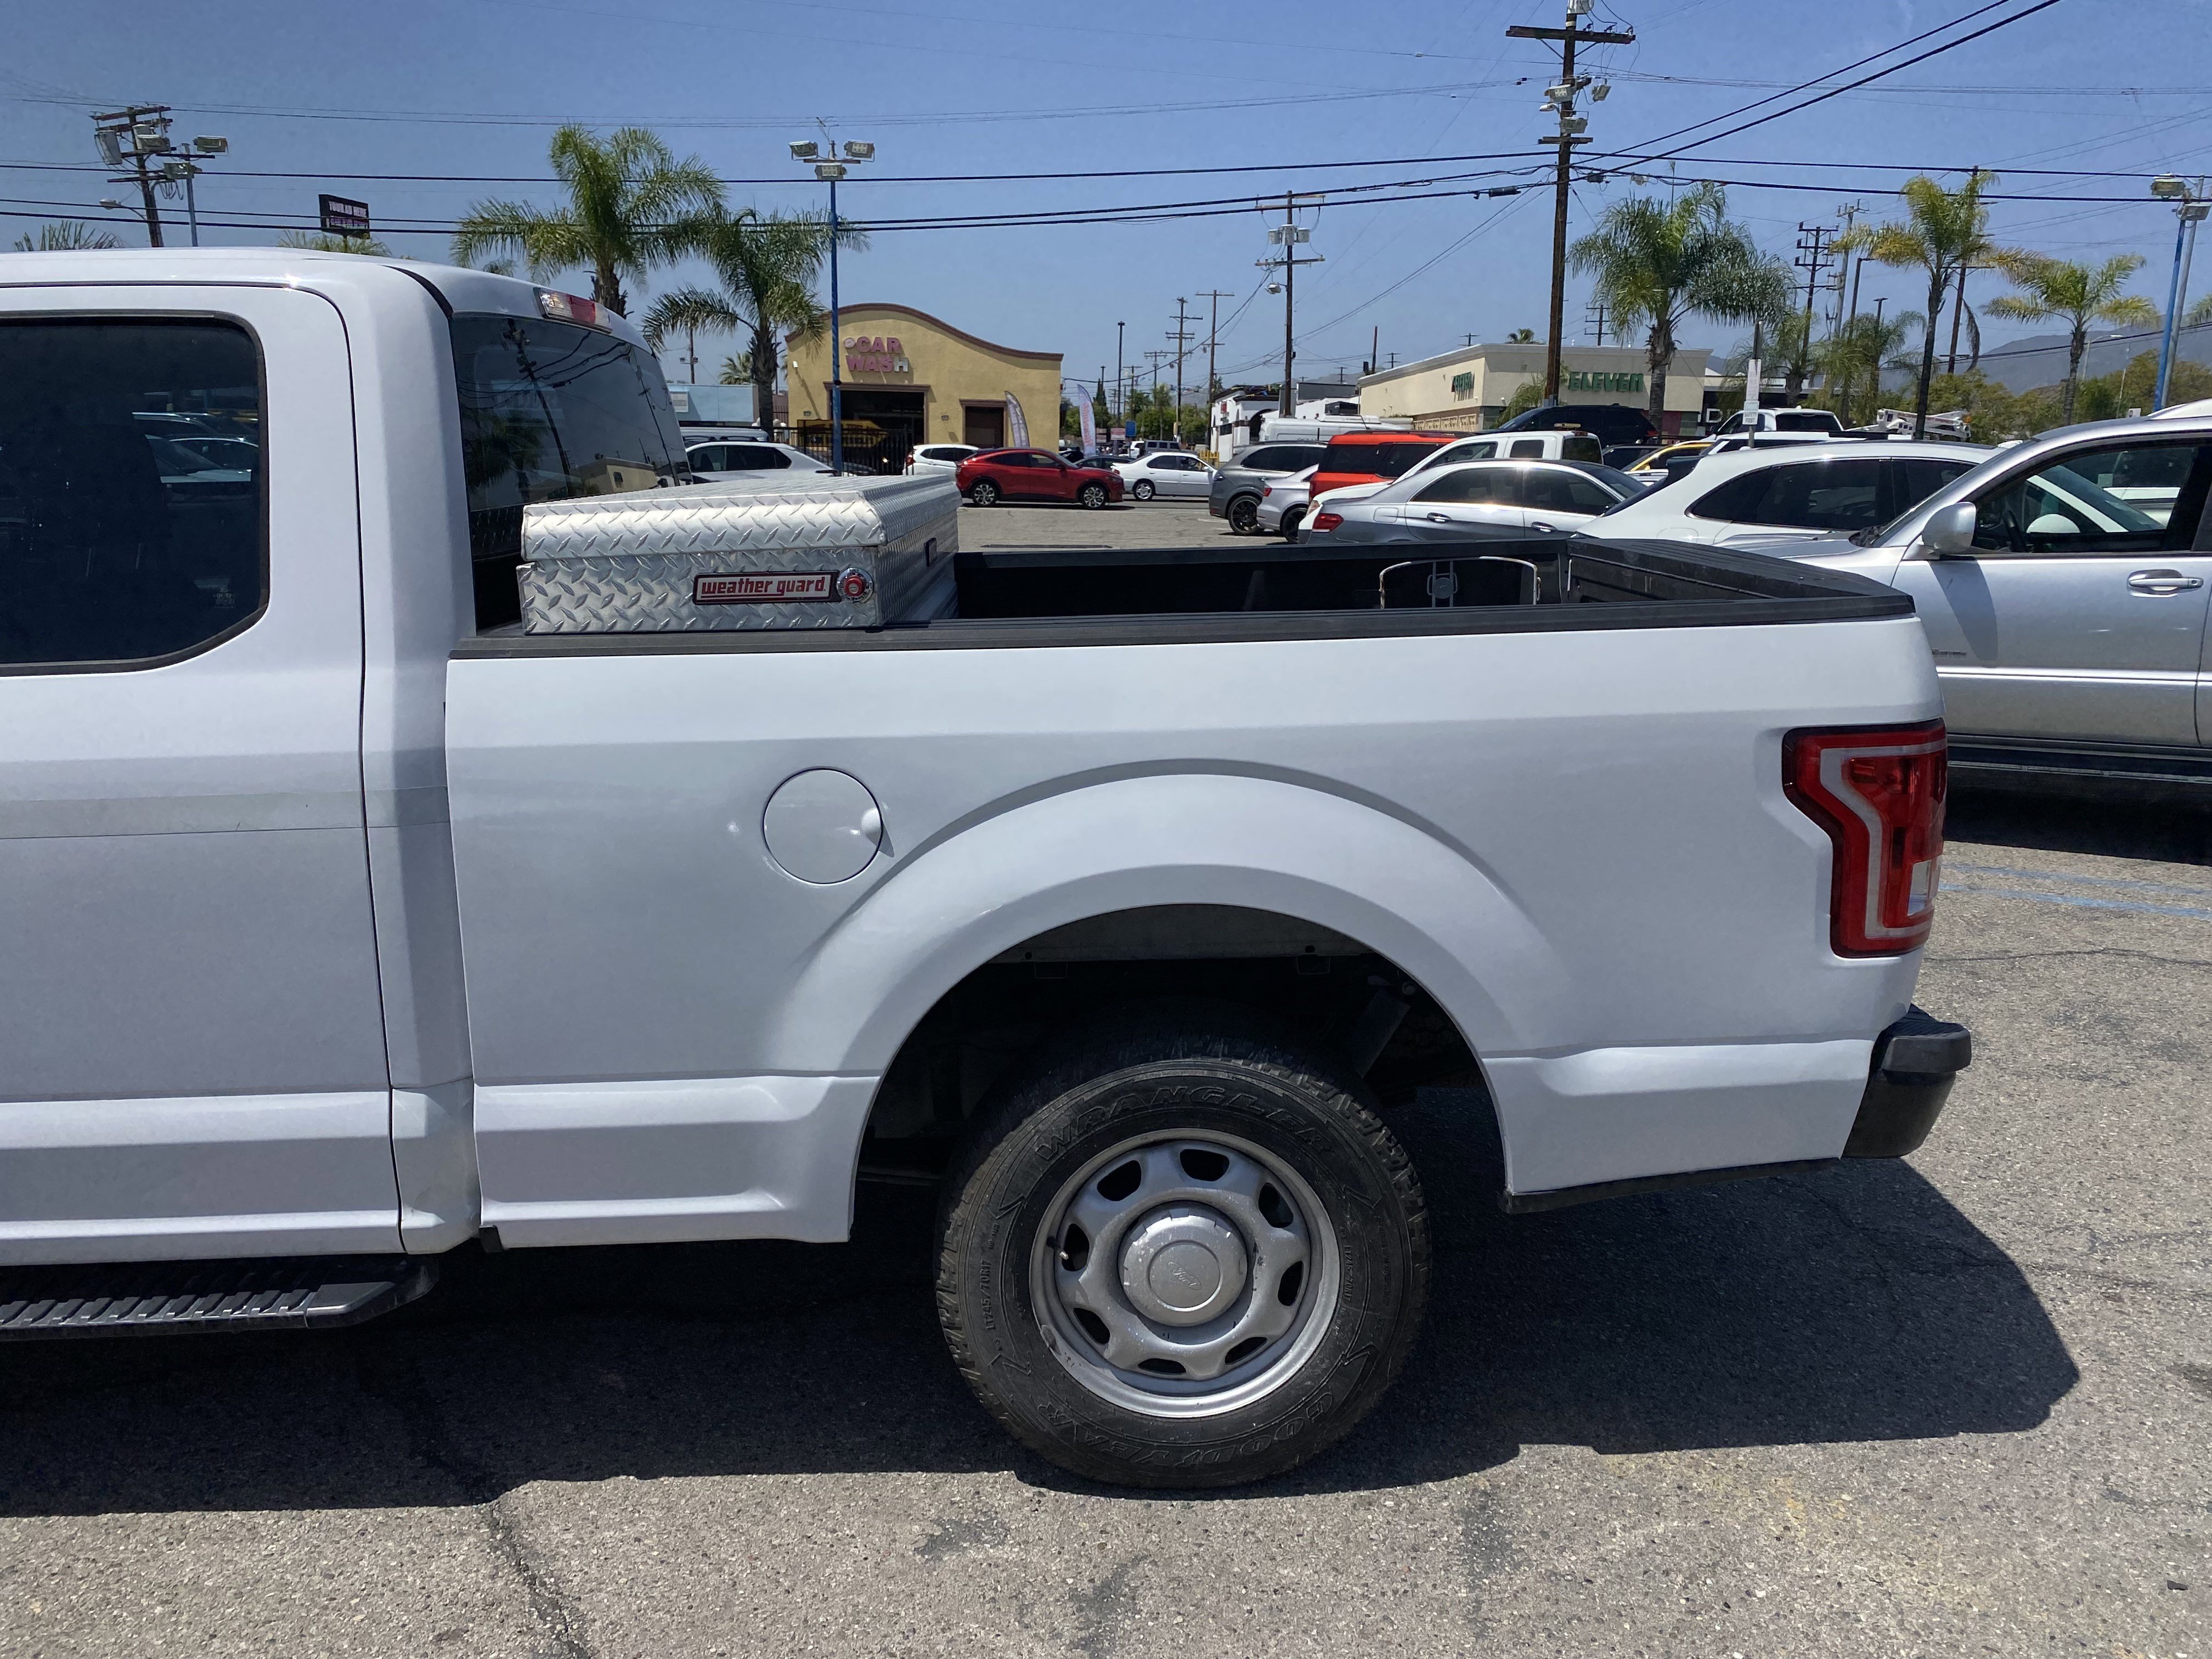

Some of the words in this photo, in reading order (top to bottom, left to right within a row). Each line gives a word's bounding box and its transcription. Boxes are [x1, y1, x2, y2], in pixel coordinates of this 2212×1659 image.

[856, 336, 901, 353] CAR
[845, 355, 909, 373] WASH
[701, 578, 772, 594] weather
[776, 576, 824, 596] guard
[1035, 1086, 1332, 1160] WRANGLER
[1036, 1393, 1333, 1467] GOODYEAR
